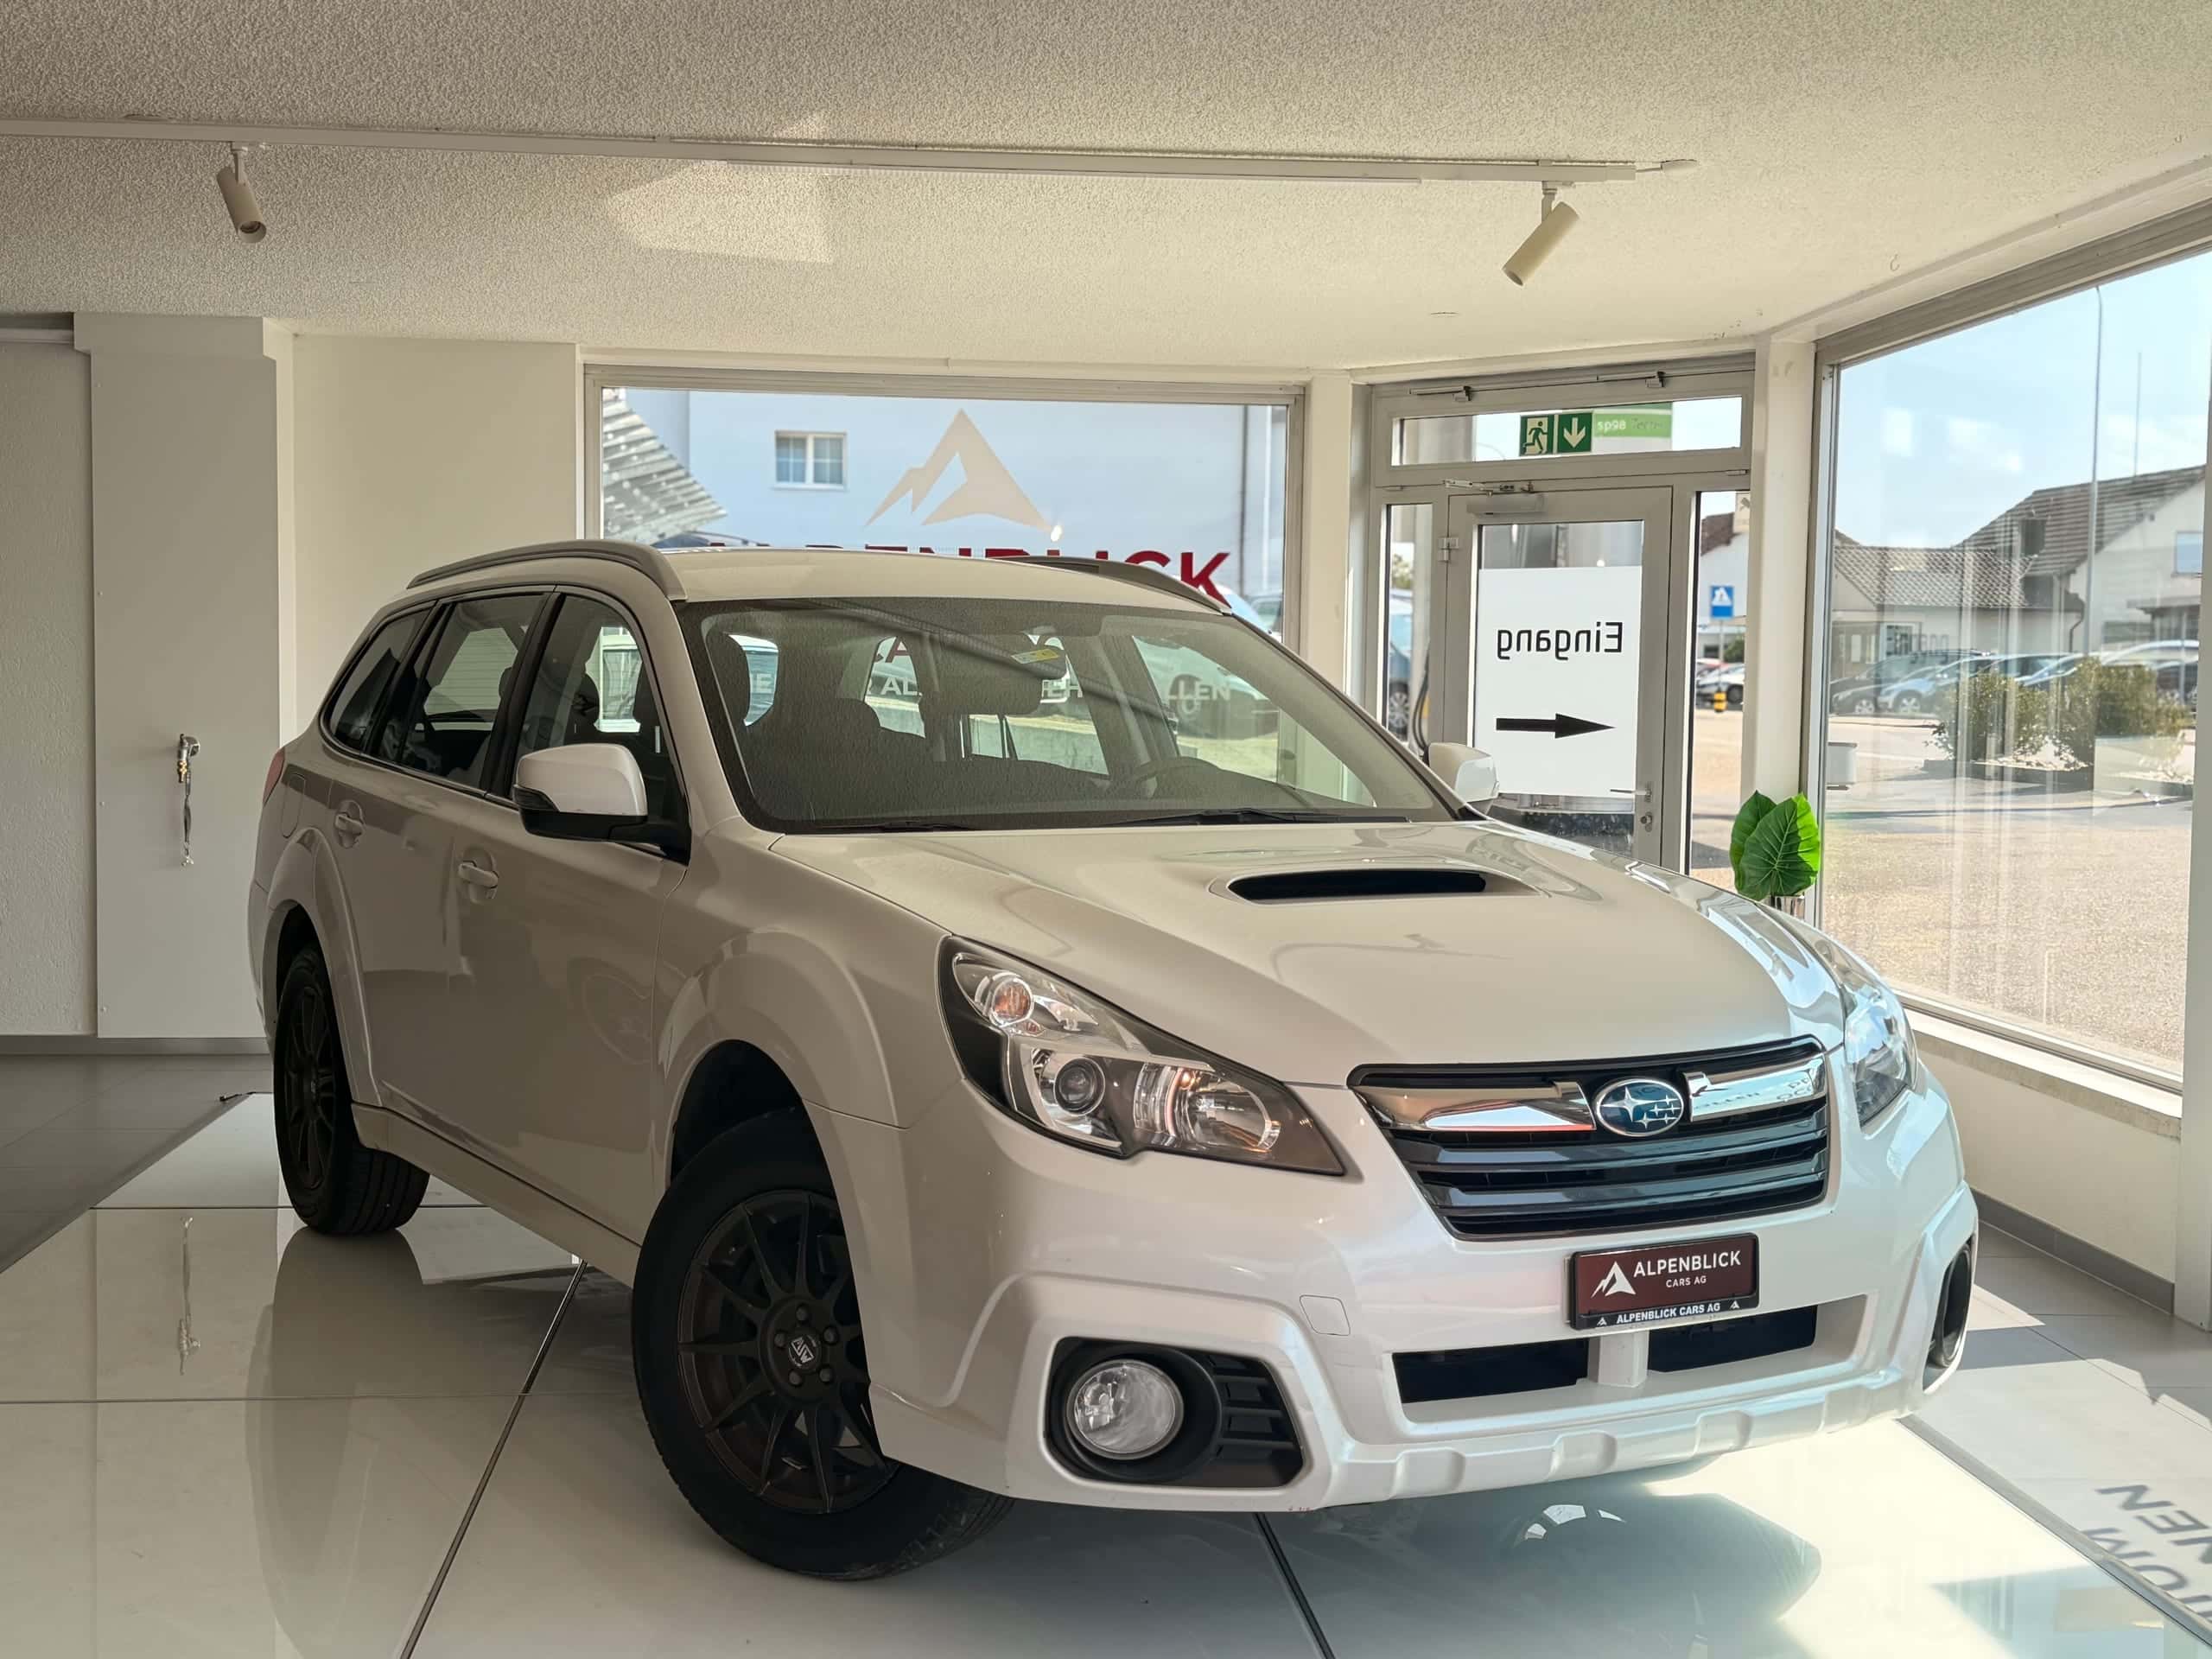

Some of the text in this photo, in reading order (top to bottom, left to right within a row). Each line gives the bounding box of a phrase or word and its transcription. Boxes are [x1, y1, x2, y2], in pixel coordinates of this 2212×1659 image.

[1633, 1249, 1741, 1278] ALPENBLICK
[1665, 1274, 1707, 1288] CARS AG
[1616, 1302, 1721, 1325] ALPENBLICK CARS AG
